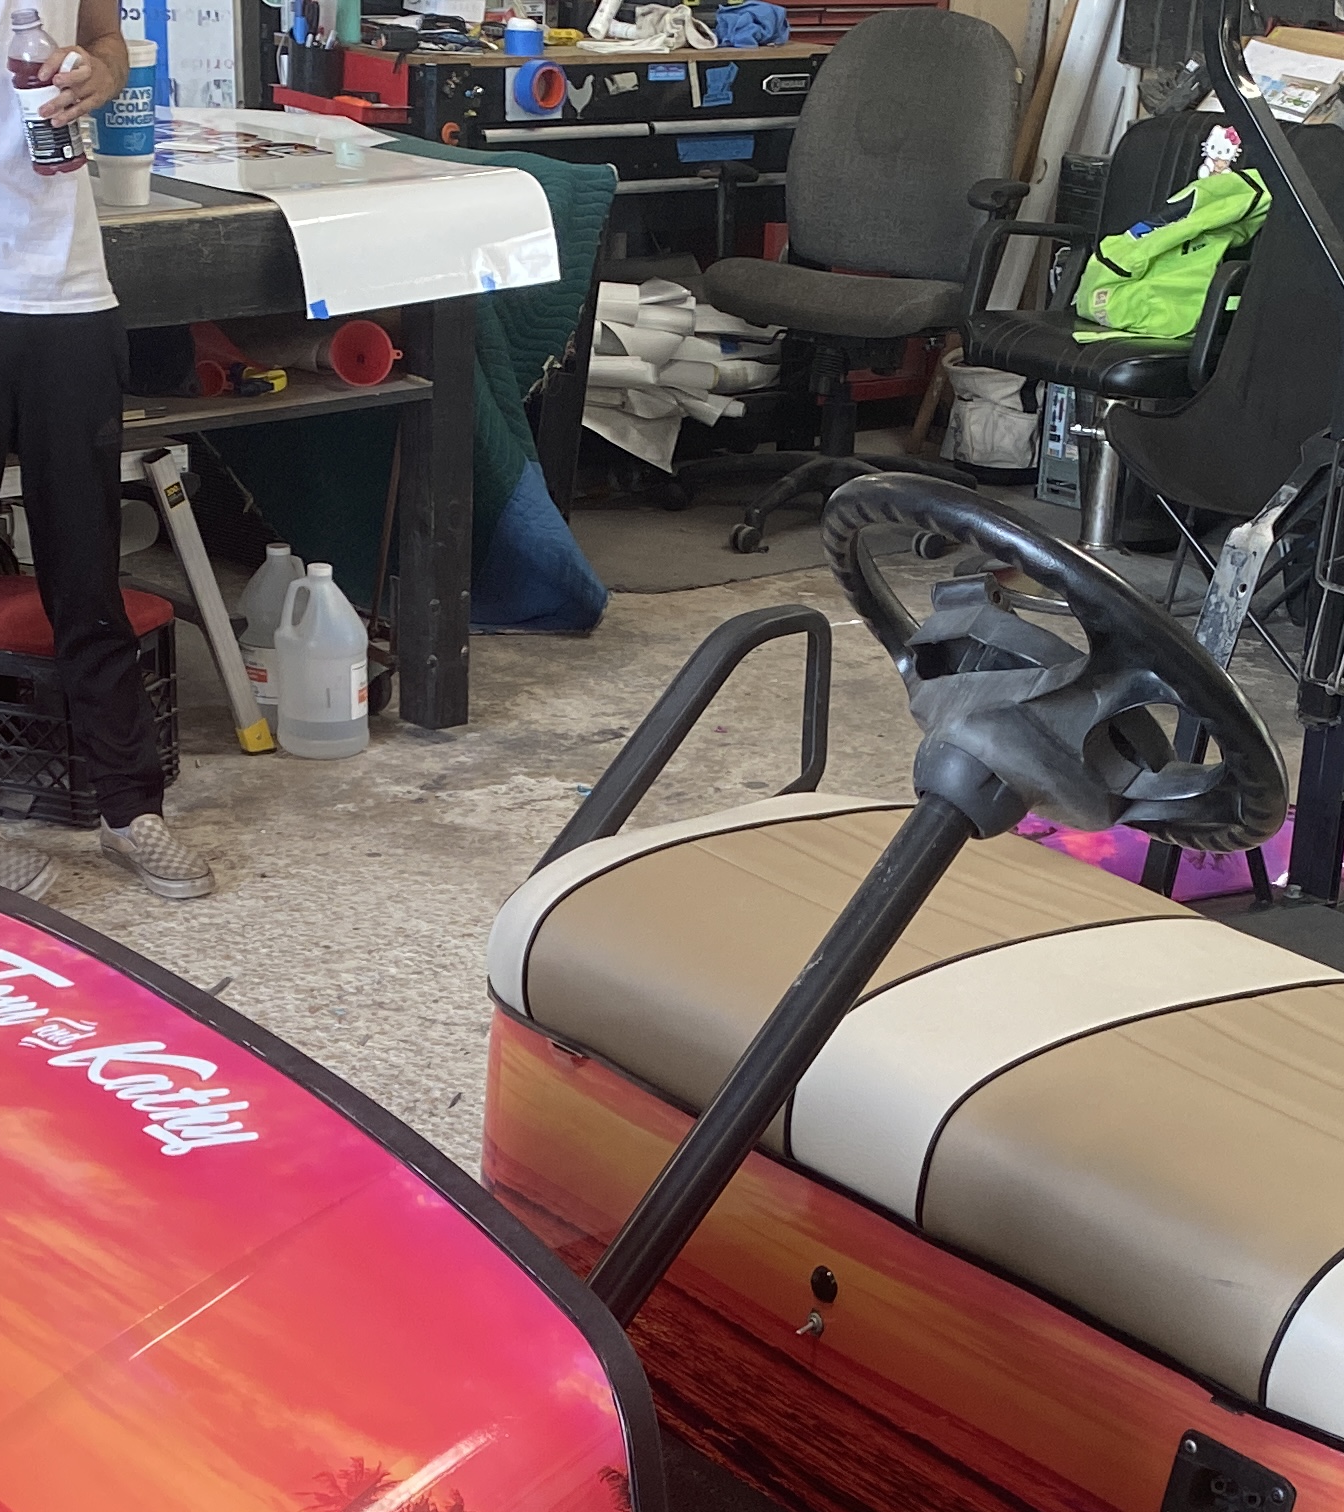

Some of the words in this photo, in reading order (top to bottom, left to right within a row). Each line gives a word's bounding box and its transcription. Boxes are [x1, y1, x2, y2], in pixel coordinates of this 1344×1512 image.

[121, 88, 151, 100] TAYS
[116, 101, 149, 113] COLD
[32, 1022, 96, 1046] and
[47, 1041, 259, 1156] Kathy
